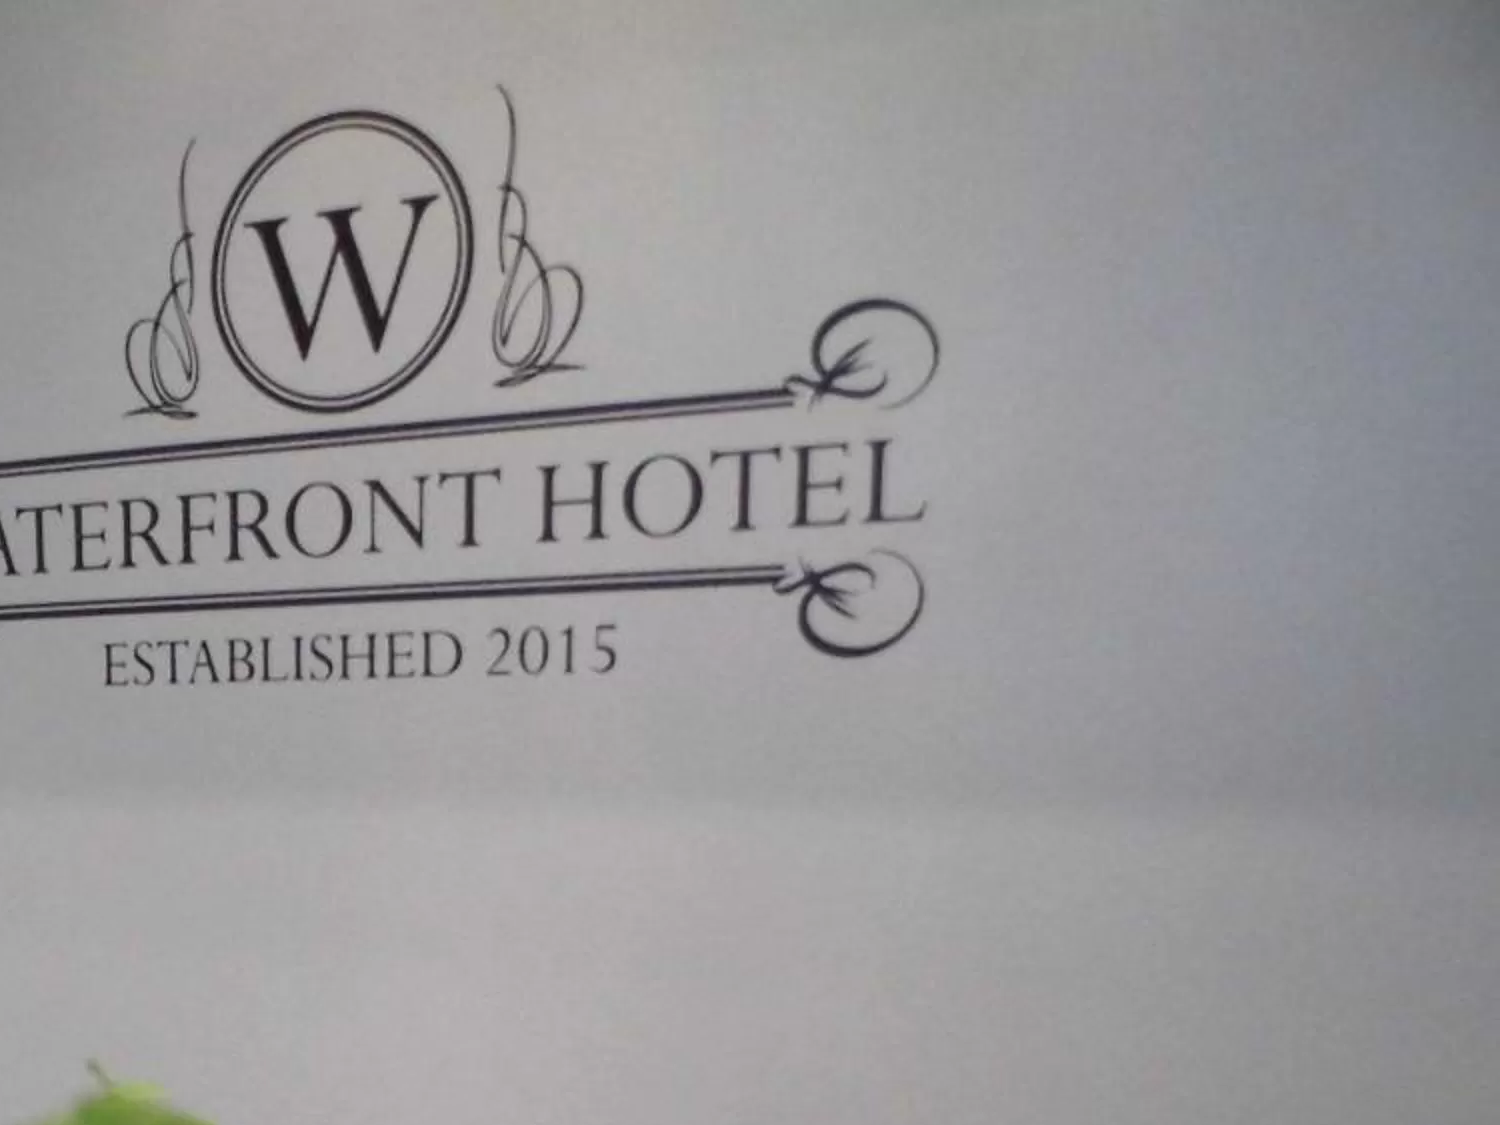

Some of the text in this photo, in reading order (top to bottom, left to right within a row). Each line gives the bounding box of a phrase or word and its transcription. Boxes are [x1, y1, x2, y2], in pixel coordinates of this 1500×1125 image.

[244, 193, 440, 362] W
[538, 438, 927, 546] HOTEL
[102, 624, 619, 690] ESTABLISHED 2015
